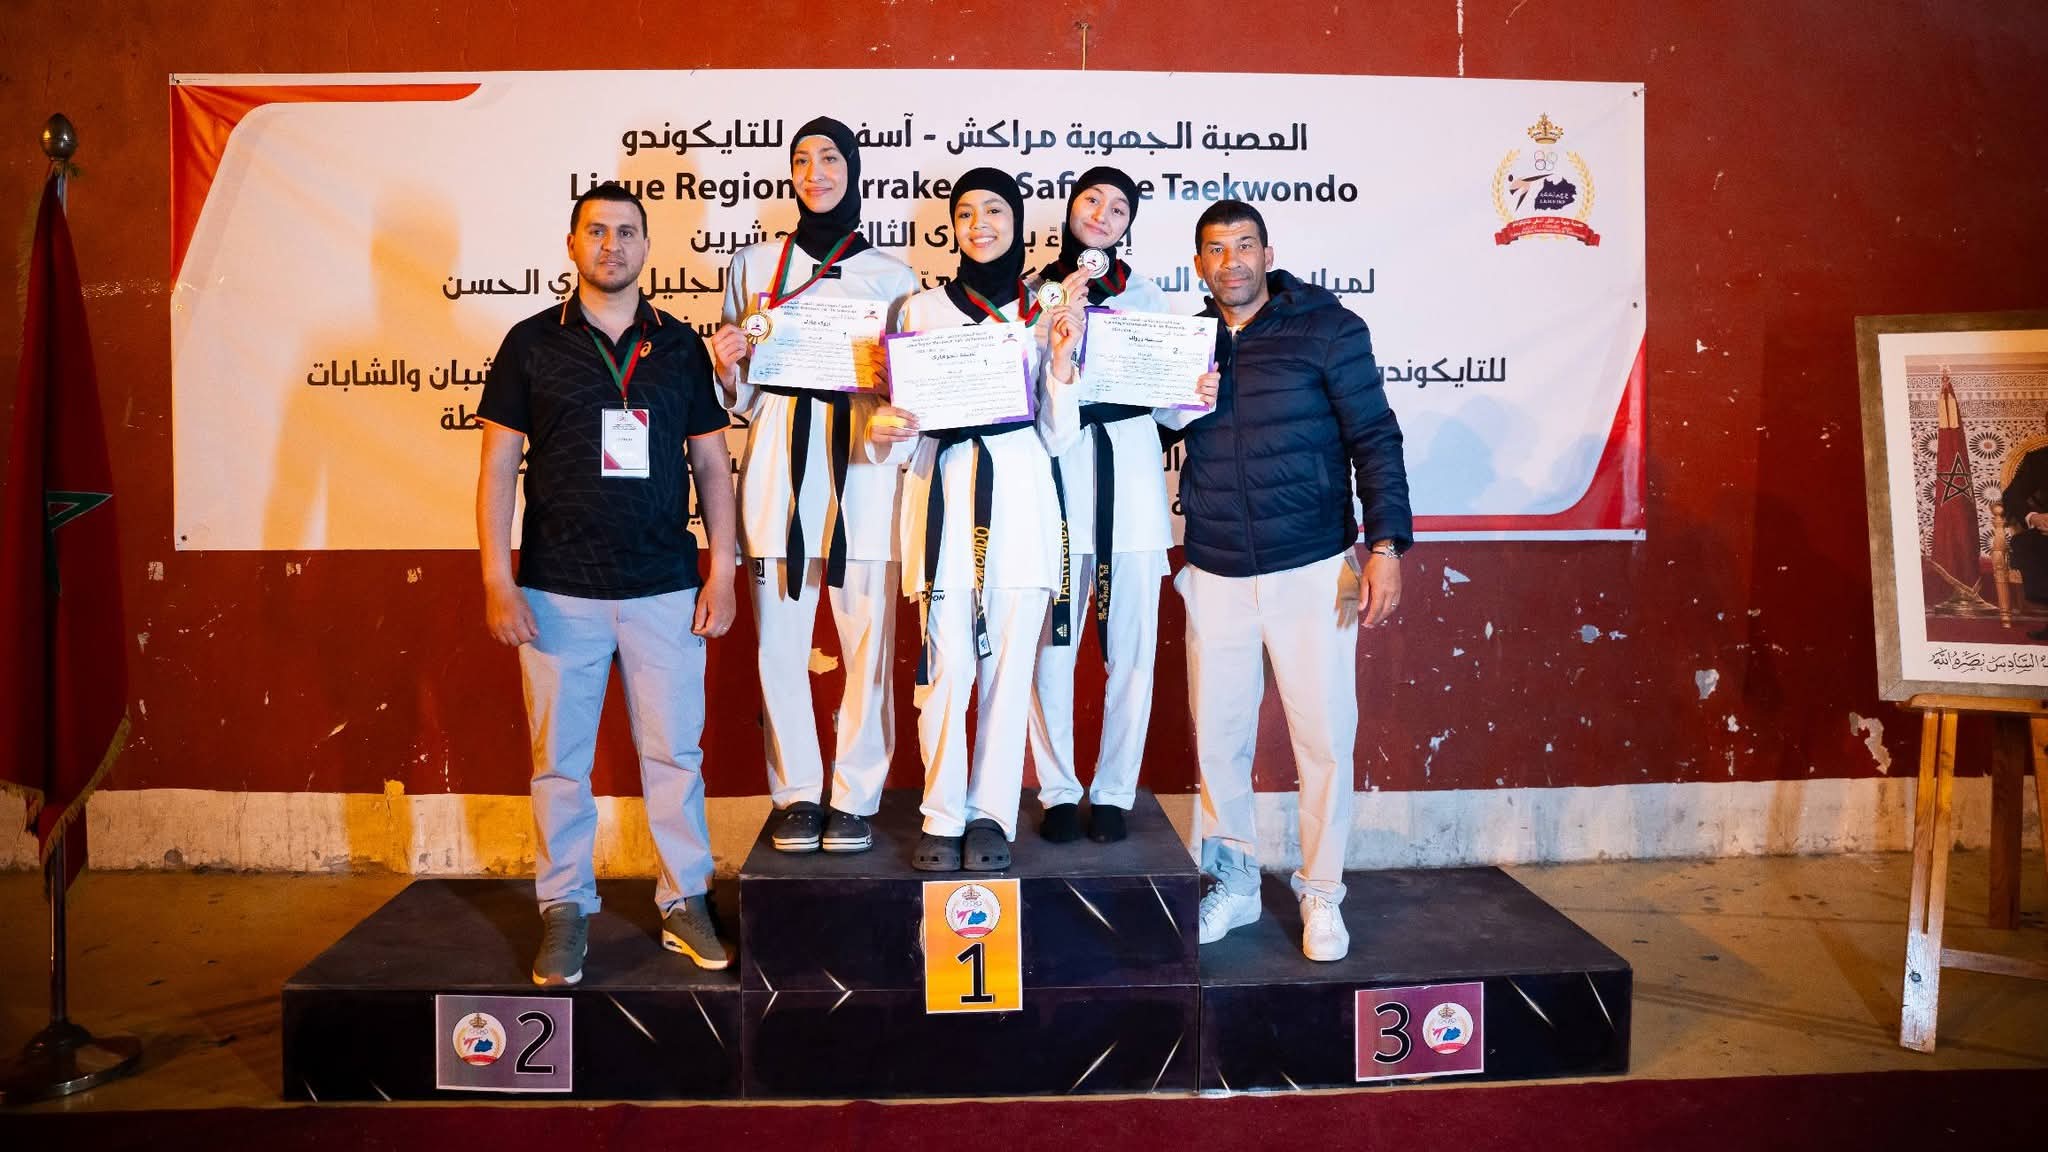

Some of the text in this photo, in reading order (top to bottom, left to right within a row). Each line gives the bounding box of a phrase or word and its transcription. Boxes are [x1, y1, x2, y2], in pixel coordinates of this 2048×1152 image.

[621, 119, 784, 156] للتايكوندو
[855, 113, 913, 148] آسف
[946, 117, 1057, 155] مراكش
[1066, 119, 1192, 156] الجهوية
[1201, 122, 1309, 156] العصبة
[1016, 170, 1077, 200] Saf
[1162, 173, 1358, 202] Taekwondo
[442, 268, 540, 300] الحسن
[638, 267, 731, 300] لجليل
[306, 357, 421, 392] والشابات
[955, 942, 996, 1005] 1
[514, 1010, 554, 1075] 2
[1373, 1001, 1412, 1064] 3
